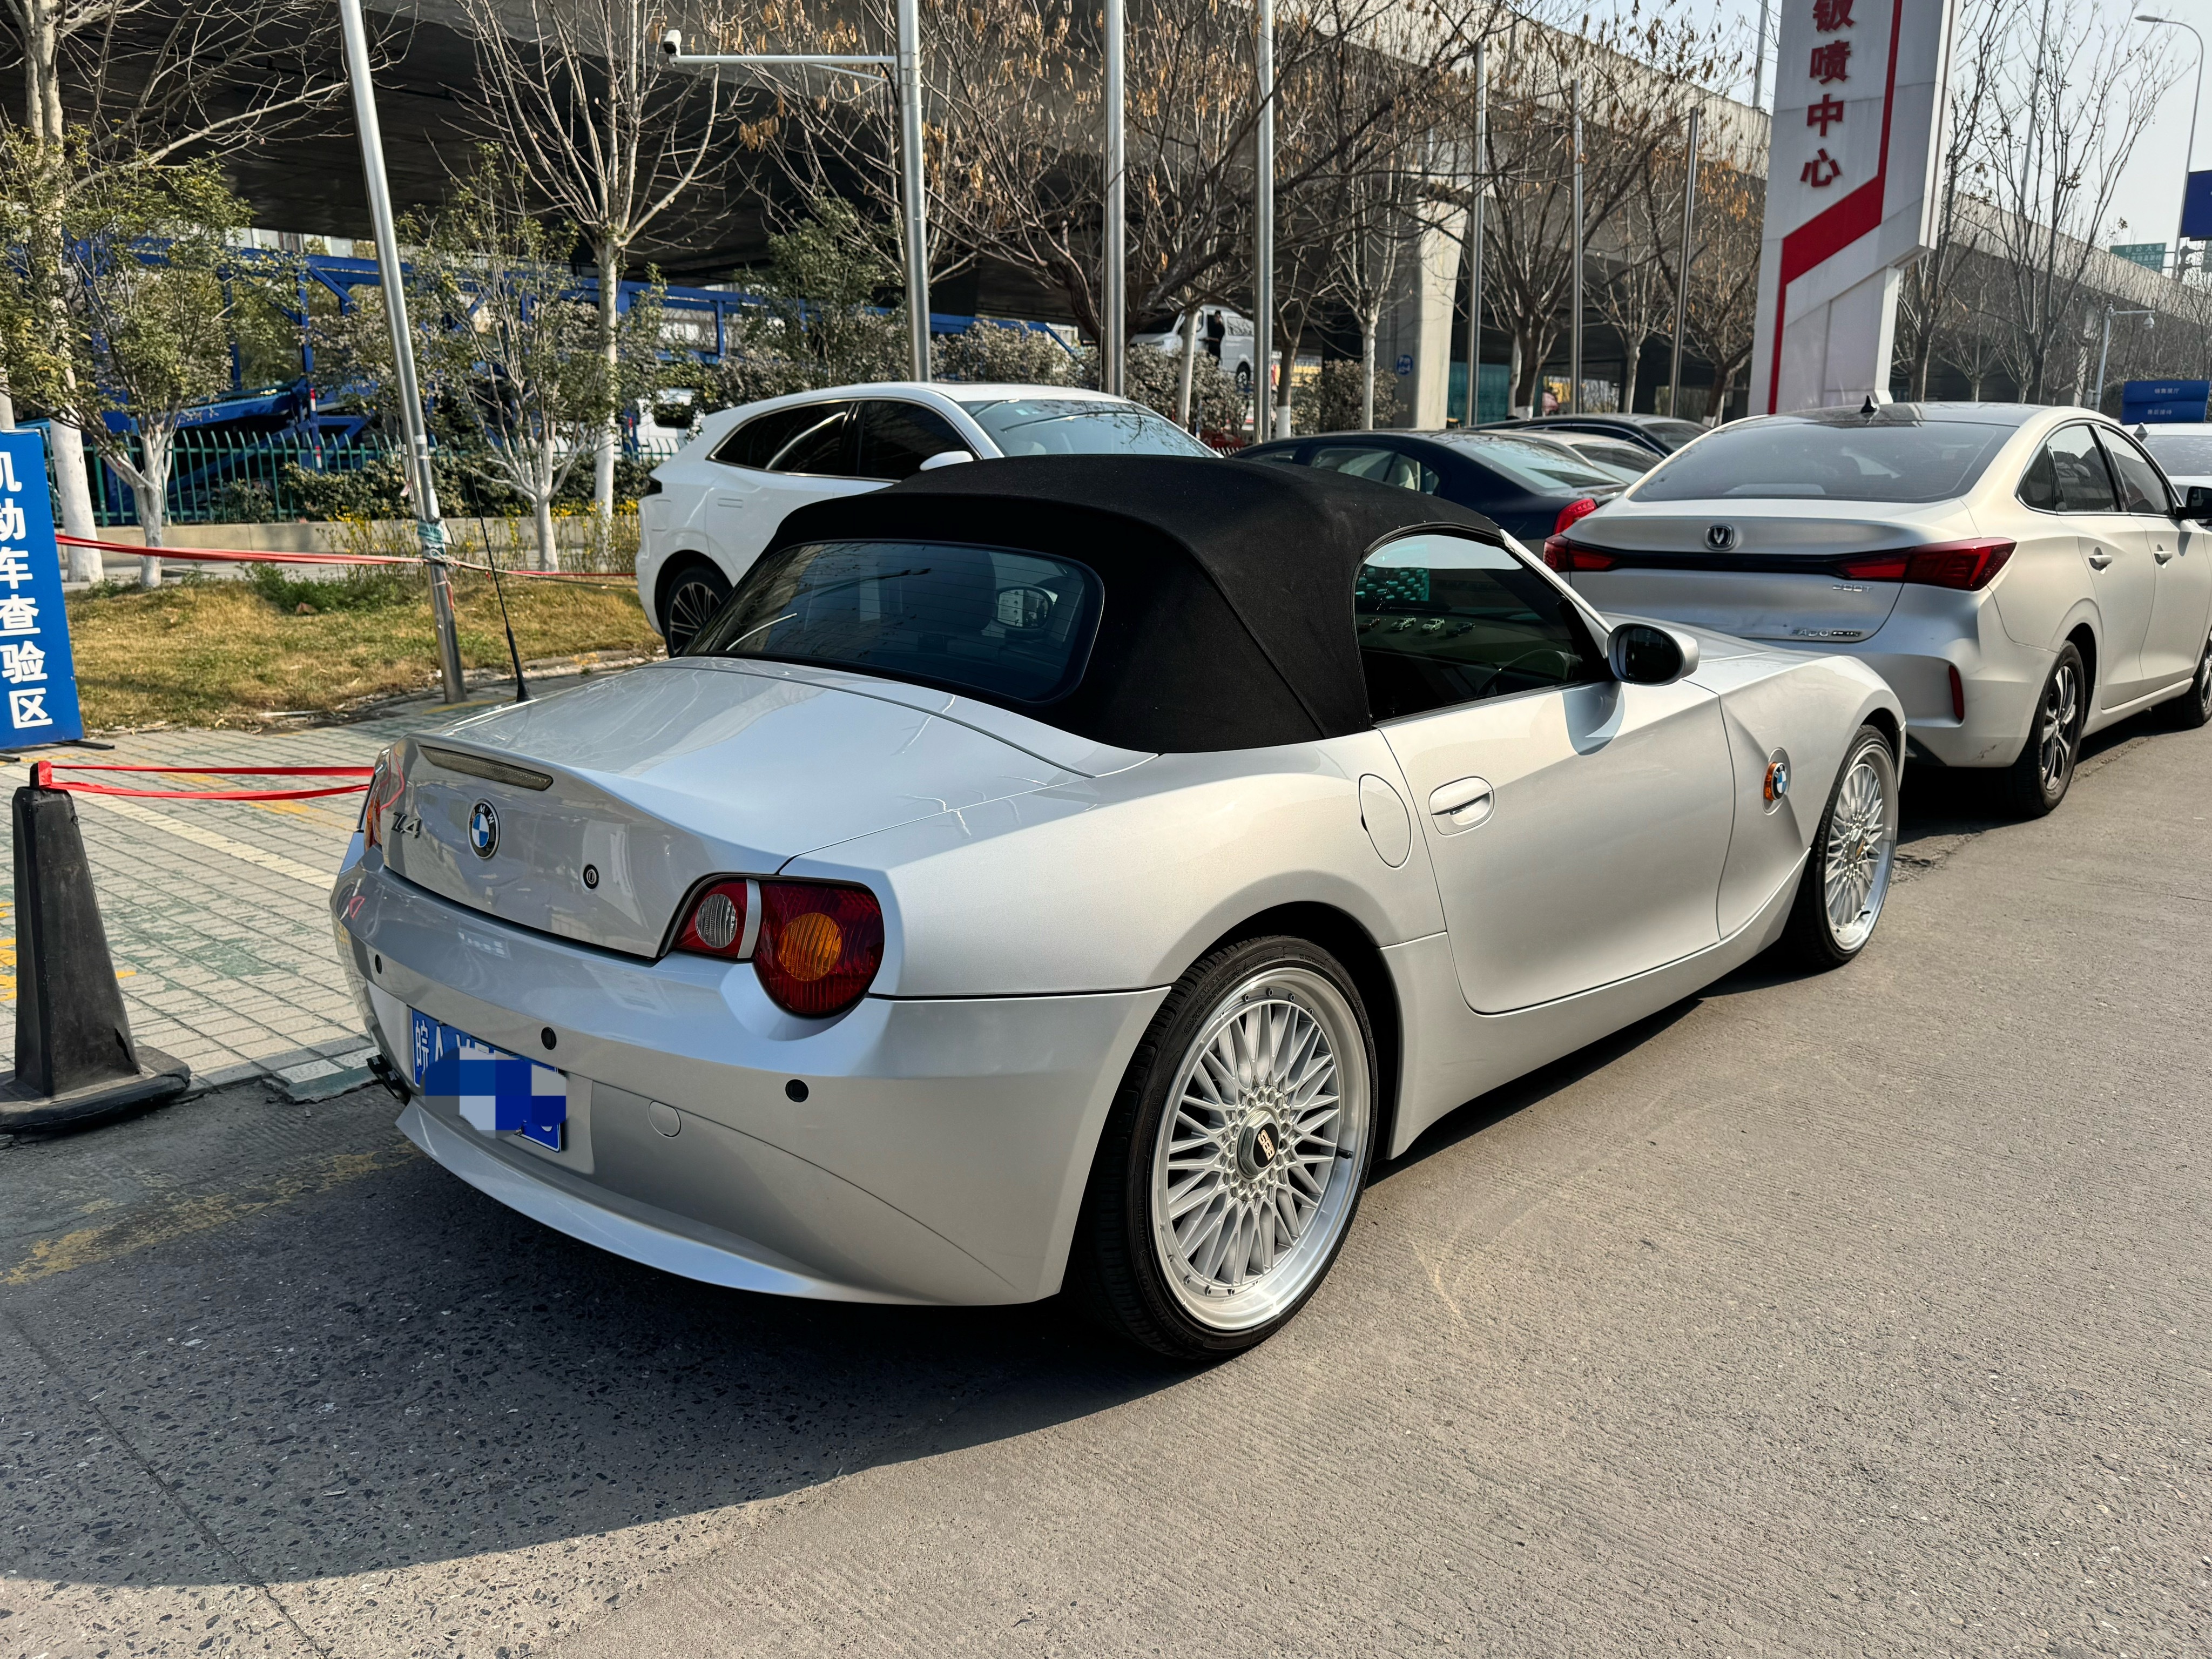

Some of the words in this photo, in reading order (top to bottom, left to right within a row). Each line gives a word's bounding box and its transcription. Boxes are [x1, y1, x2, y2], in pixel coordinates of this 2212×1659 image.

[1800, 0, 1854, 187] 钣喷中心
[391, 811, 423, 838] Z4
[1257, 1129, 1276, 1161] BBS
